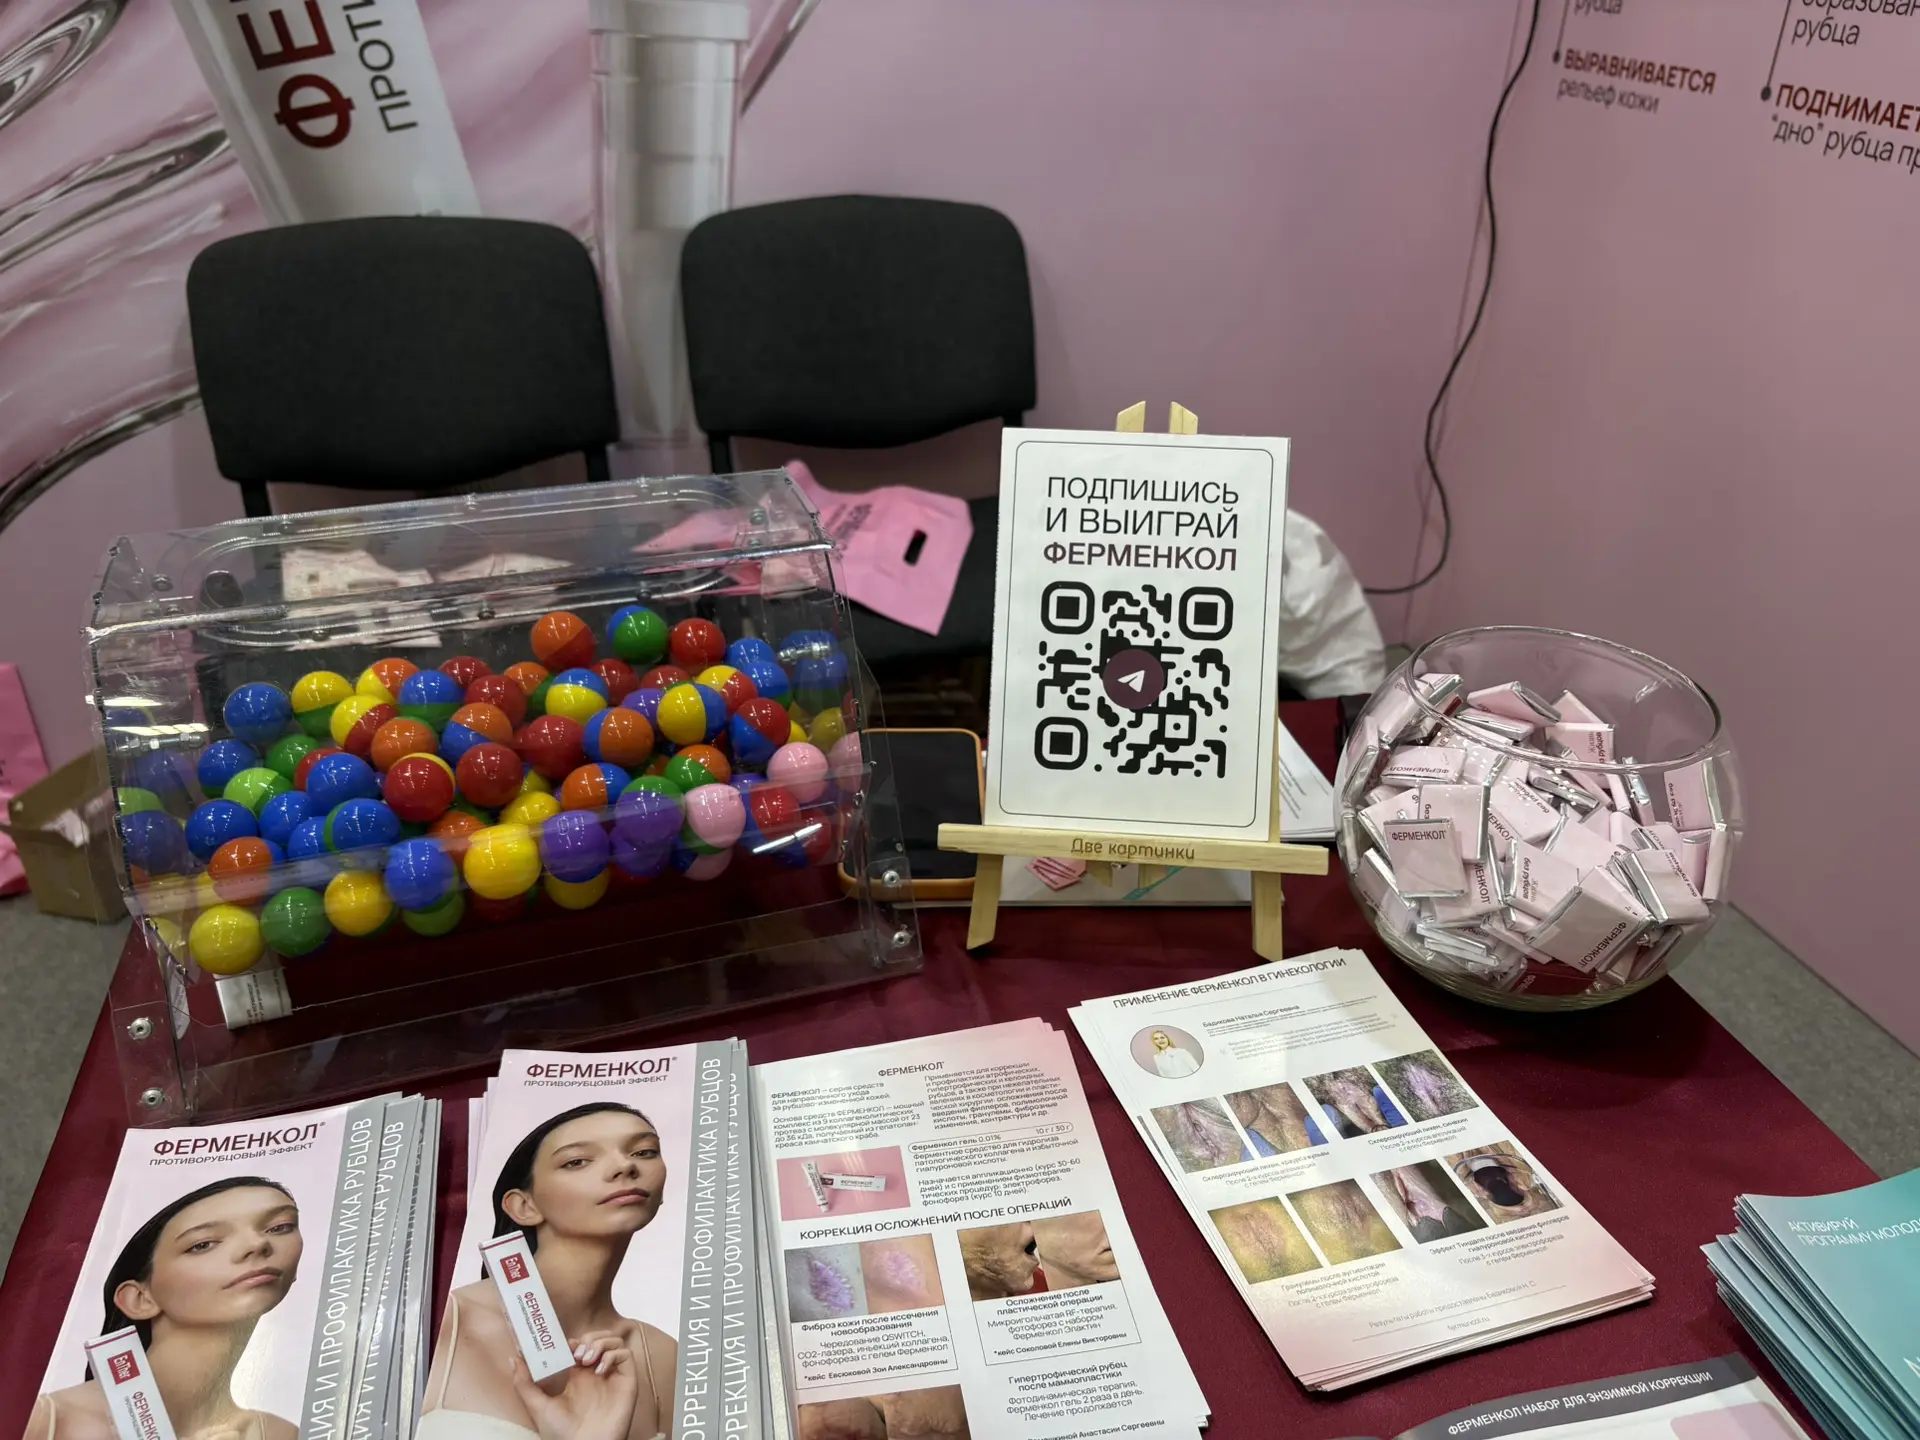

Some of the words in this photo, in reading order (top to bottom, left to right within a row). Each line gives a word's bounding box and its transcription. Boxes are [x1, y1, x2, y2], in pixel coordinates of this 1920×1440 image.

[1791, 17, 1860, 47] рубца
[1564, 49, 1716, 94] ВЫРАВНИВАЕТСЯ
[1557, 78, 1616, 110] рельеф
[1618, 91, 1660, 113] кожи
[1824, 130, 1894, 163] рубца
[1048, 476, 1239, 504] ПОДПИШИСЬ
[1045, 508, 1067, 532] И
[1080, 507, 1238, 538] ВЫИГРАЙ
[1043, 542, 1237, 571] ФЕРМЕНКОЛ
[1391, 829, 1447, 841] ФЕРМЕНКОЛ
[1071, 838, 1103, 854] Две
[1108, 842, 1195, 861] картинки
[1579, 921, 1627, 967] ФЕРМЕНКОЛ
[1113, 987, 1190, 1009] ПРИМЕНЕНИЕ
[1190, 975, 1258, 995] ФЕРМЕНКОЛ
[1259, 973, 1268, 983] В
[1268, 957, 1347, 981] ГИНЕКОЛОГИИ
[523, 1077, 626, 1088] ПРОТИВОРУБЦОВЫЙ
[627, 1074, 668, 1085] ЭФФЕКТ
[924, 1069, 975, 1082] Применяется
[700, 1058, 724, 1126] РУБЦОВ
[773, 1114, 801, 1124] Основа
[836, 1105, 884, 1116] ФЕРМЕНКОЛ
[149, 1149, 267, 1166] ПРОТИВОРУБЦОВЫЙ
[268, 1142, 314, 1158] ЭФФЕКТ
[344, 1118, 373, 1190] РУБЦОВ
[911, 1139, 957, 1152] Ферменкол
[912, 1147, 967, 1161] Ферментное
[968, 1143, 1001, 1154] средство
[915, 1160, 972, 1174] гиалуроновой
[918, 1173, 970, 1186] Назначается
[971, 1164, 1033, 1179] аппликационно
[956, 1174, 1013, 1188] применением
[920, 1189, 957, 1199] тических
[922, 1194, 969, 1207] фонофорез
[691, 1128, 718, 1288] ПРОФИЛАКТИКА
[800, 1222, 872, 1243] КОРРЕКЦИЯ
[875, 1210, 961, 1232] ОСЛОЖНЕНИЙ
[965, 1206, 1005, 1221] ПОСЛЕ
[1007, 1195, 1072, 1215] ОПЕРАЦИЙ
[1788, 1216, 1859, 1232] АКТИВИРУЙ
[1797, 1230, 1873, 1247] ПРОГРАММУ
[318, 1192, 363, 1367] ПРОФИЛАКТИКА
[690, 1295, 711, 1311] И
[996, 1300, 1059, 1315] пластической
[1058, 1293, 1103, 1306] операции
[1006, 1294, 1062, 1306] Осложнение
[1063, 1288, 1090, 1299] после
[801, 1320, 835, 1332] Фиброз
[837, 1318, 860, 1327] кожи
[861, 1314, 888, 1324] после
[889, 1308, 938, 1321] иссечения
[830, 1319, 912, 1338] новообразования
[987, 1310, 1065, 1328] Микроигольчатая
[1064, 1313, 1104, 1325] набором
[819, 1334, 880, 1350] Чередование
[1012, 1326, 1063, 1341] Ферменкол
[1015, 1341, 1057, 1353] Соколовой
[1082, 1332, 1127, 1344] Викторовны
[801, 1353, 859, 1368] фонофореза
[867, 1350, 895, 1359] гелем
[896, 1342, 948, 1356] Ферменкол
[828, 1367, 871, 1379] Евсюковой
[887, 1358, 948, 1372] Александровны
[1008, 1363, 1098, 1385] Гипертрофический
[1098, 1359, 1127, 1372] рубец
[315, 1372, 339, 1392] И
[1018, 1381, 1046, 1391] после
[1047, 1370, 1122, 1387] маммопластики
[1006, 1400, 1059, 1416] Ферменкол
[1059, 1397, 1082, 1407] гель
[1089, 1393, 1112, 1404] раза
[1007, 1385, 1097, 1406] Фотодинамическая
[1448, 1405, 1522, 1436] ФЕРМЕНКОЛ
[1522, 1399, 1560, 1416] НАБОР
[1562, 1394, 1586, 1409] ДЛЯ
[1586, 1382, 1649, 1403] ЭНЗИМНОЙ
[1648, 1371, 1713, 1391] КОРРЕКЦИИ
[1023, 1408, 1065, 1421] Лечение
[1065, 1398, 1134, 1416] продолжается
[1079, 1426, 1121, 1438] Анастасии
[1121, 1419, 1165, 1432] Сергеевны
